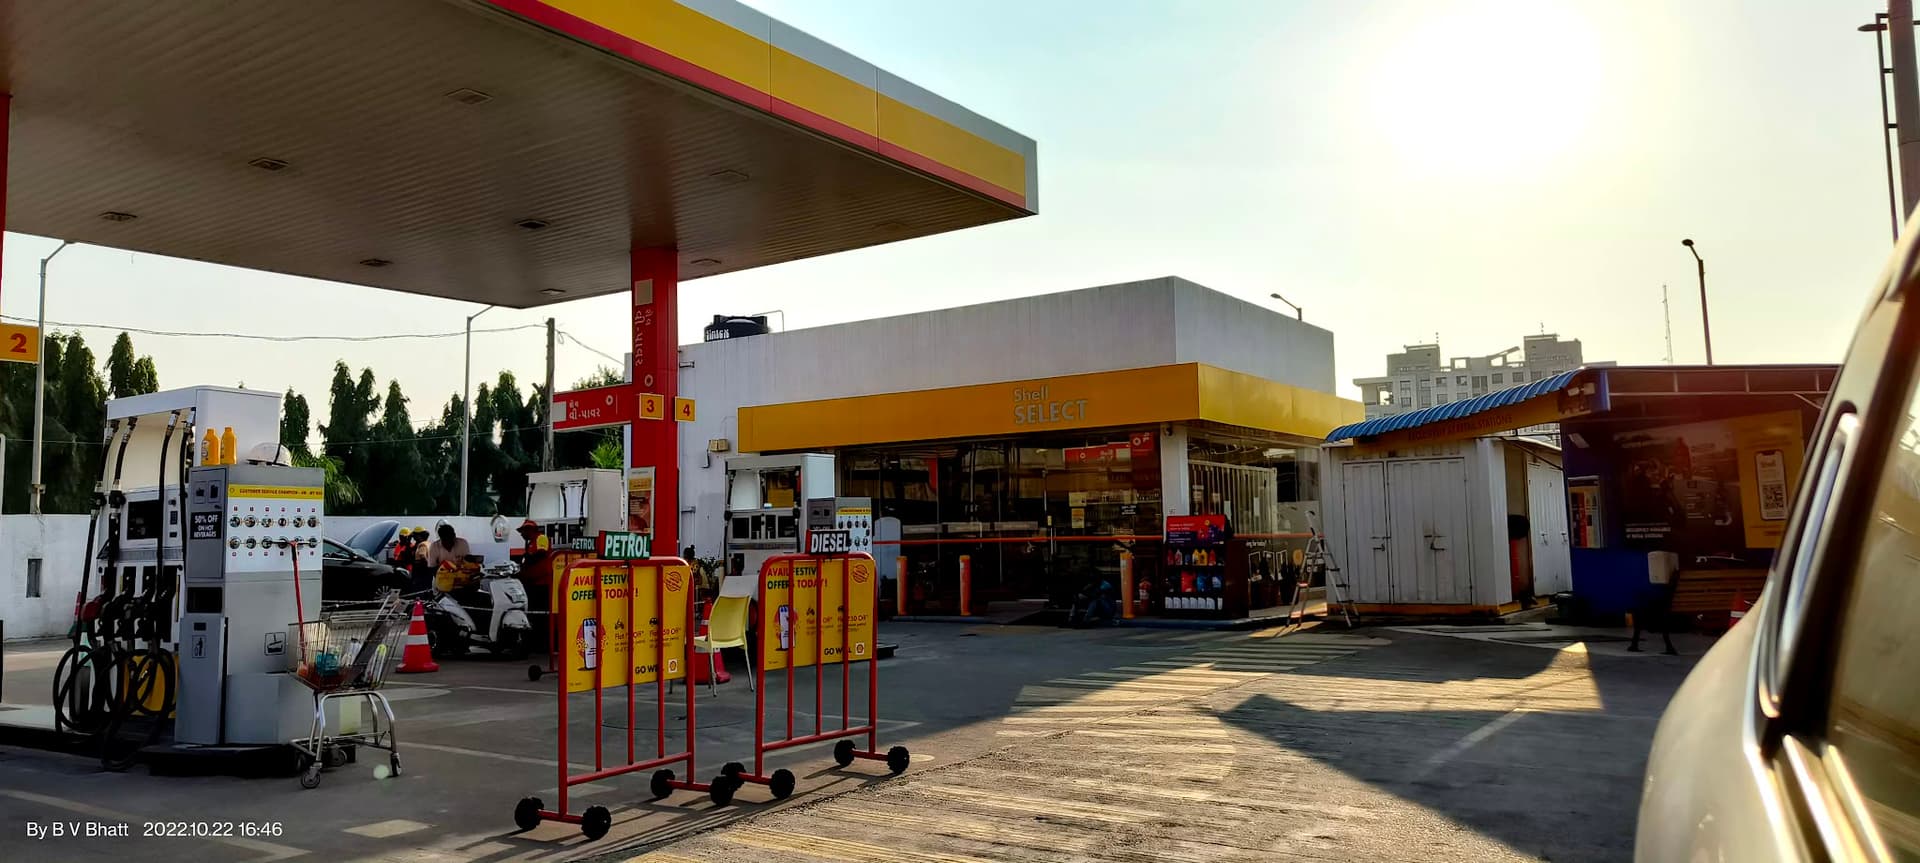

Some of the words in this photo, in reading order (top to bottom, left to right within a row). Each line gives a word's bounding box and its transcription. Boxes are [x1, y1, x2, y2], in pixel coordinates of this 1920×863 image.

[9, 332, 27, 353] 2
[1014, 385, 1048, 402] Shell
[646, 399, 655, 413] 3
[682, 403, 691, 417] 4
[1014, 399, 1089, 424] SELECT
[207, 514, 218, 523] OFF
[571, 537, 595, 551] PETROL
[604, 533, 650, 558] PETROL
[810, 533, 849, 553] DIESEL
[573, 575, 597, 586] AVAI
[824, 647, 834, 656] GO
[635, 665, 646, 674] GO
